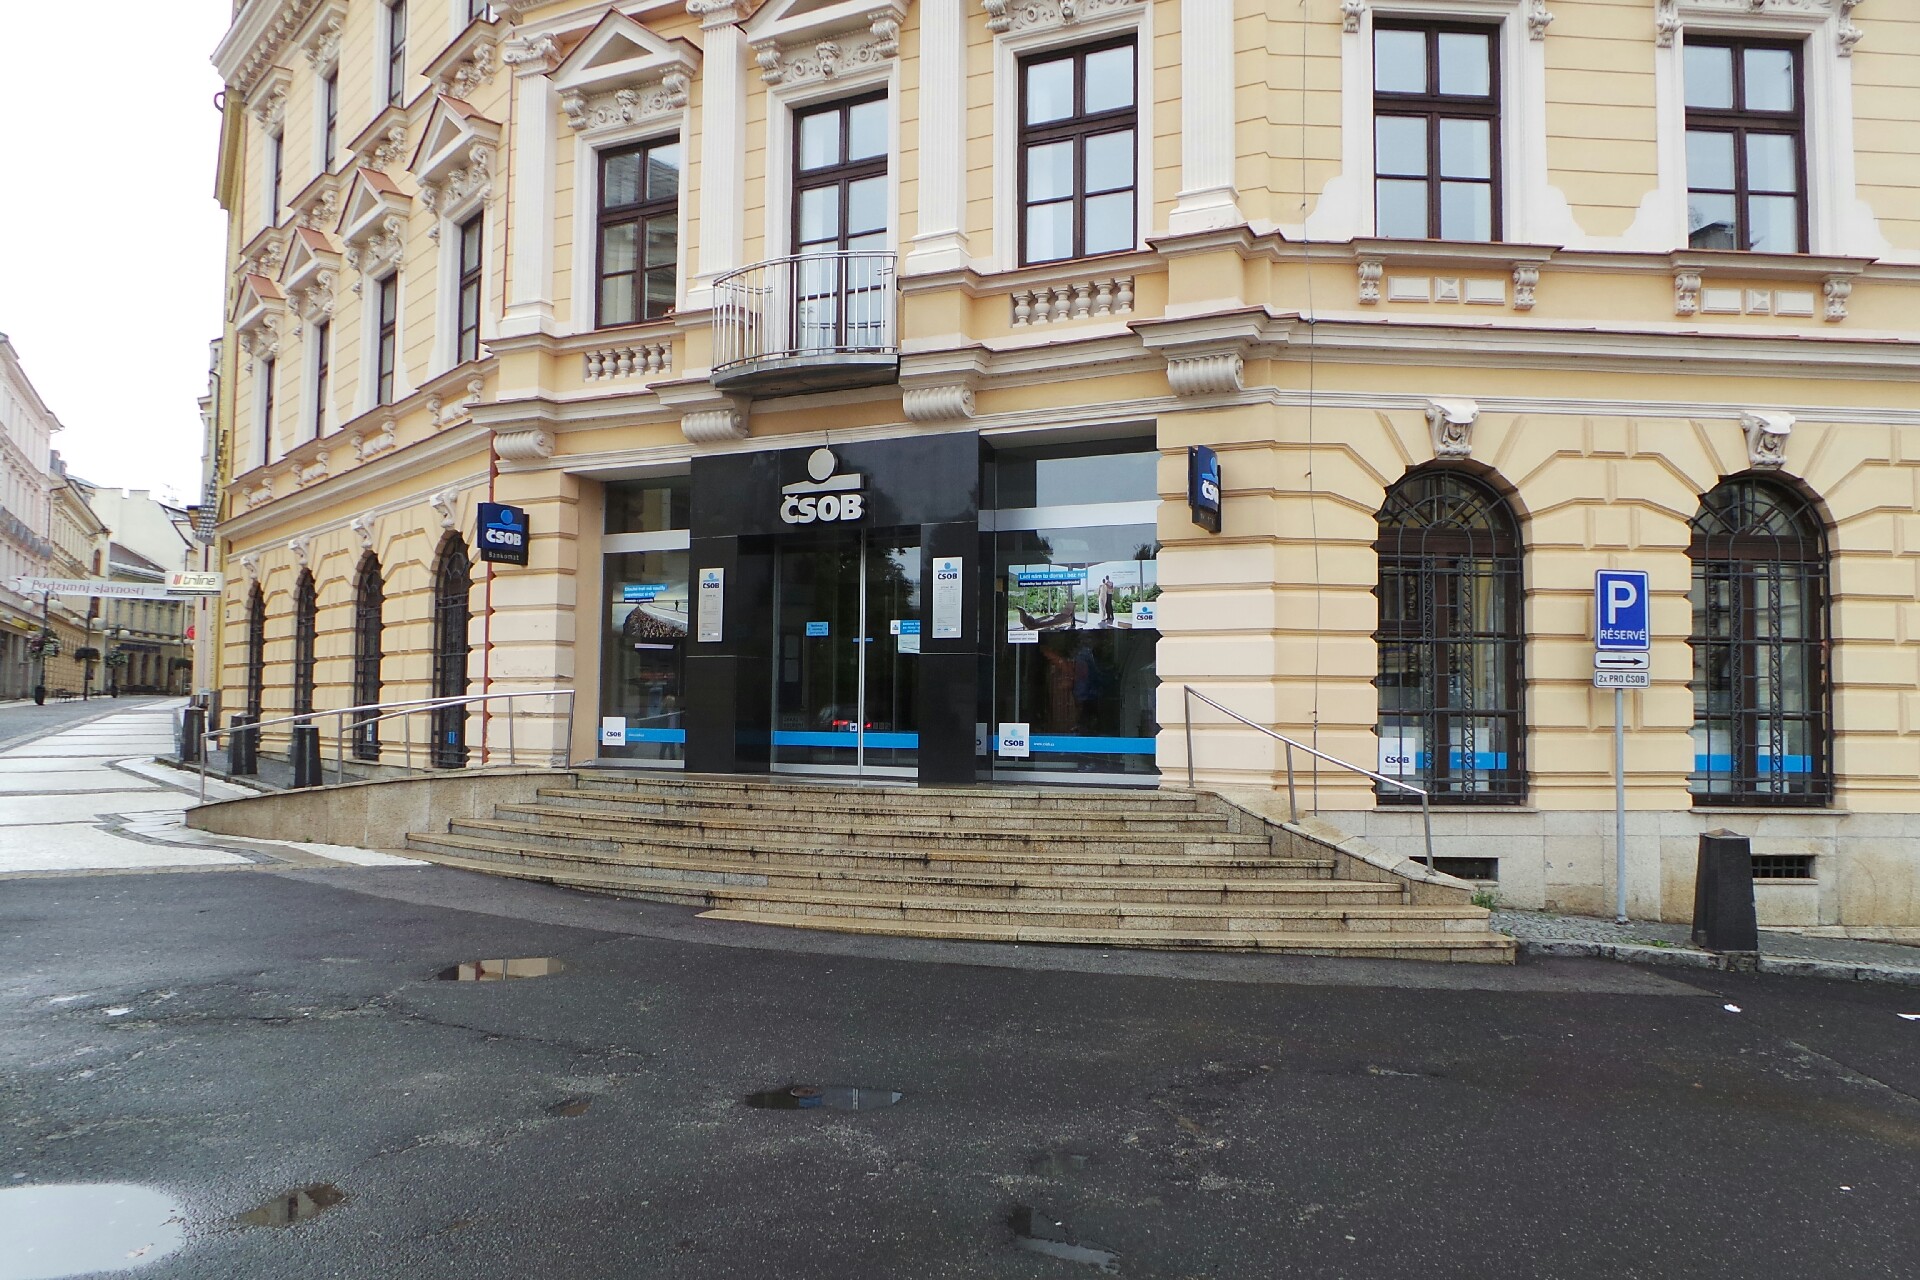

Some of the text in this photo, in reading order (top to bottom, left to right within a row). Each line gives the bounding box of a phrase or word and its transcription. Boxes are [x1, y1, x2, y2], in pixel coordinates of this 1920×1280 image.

[780, 494, 863, 524] ČSOB
[486, 528, 522, 546] ČSOB
[488, 551, 520, 561] Bankomat
[1607, 580, 1637, 624] P
[1600, 628, 1646, 640] RÉSERVÉ
[1598, 673, 1646, 684] 2x PRO ČSOB
[1003, 739, 1024, 747] ČSOB
